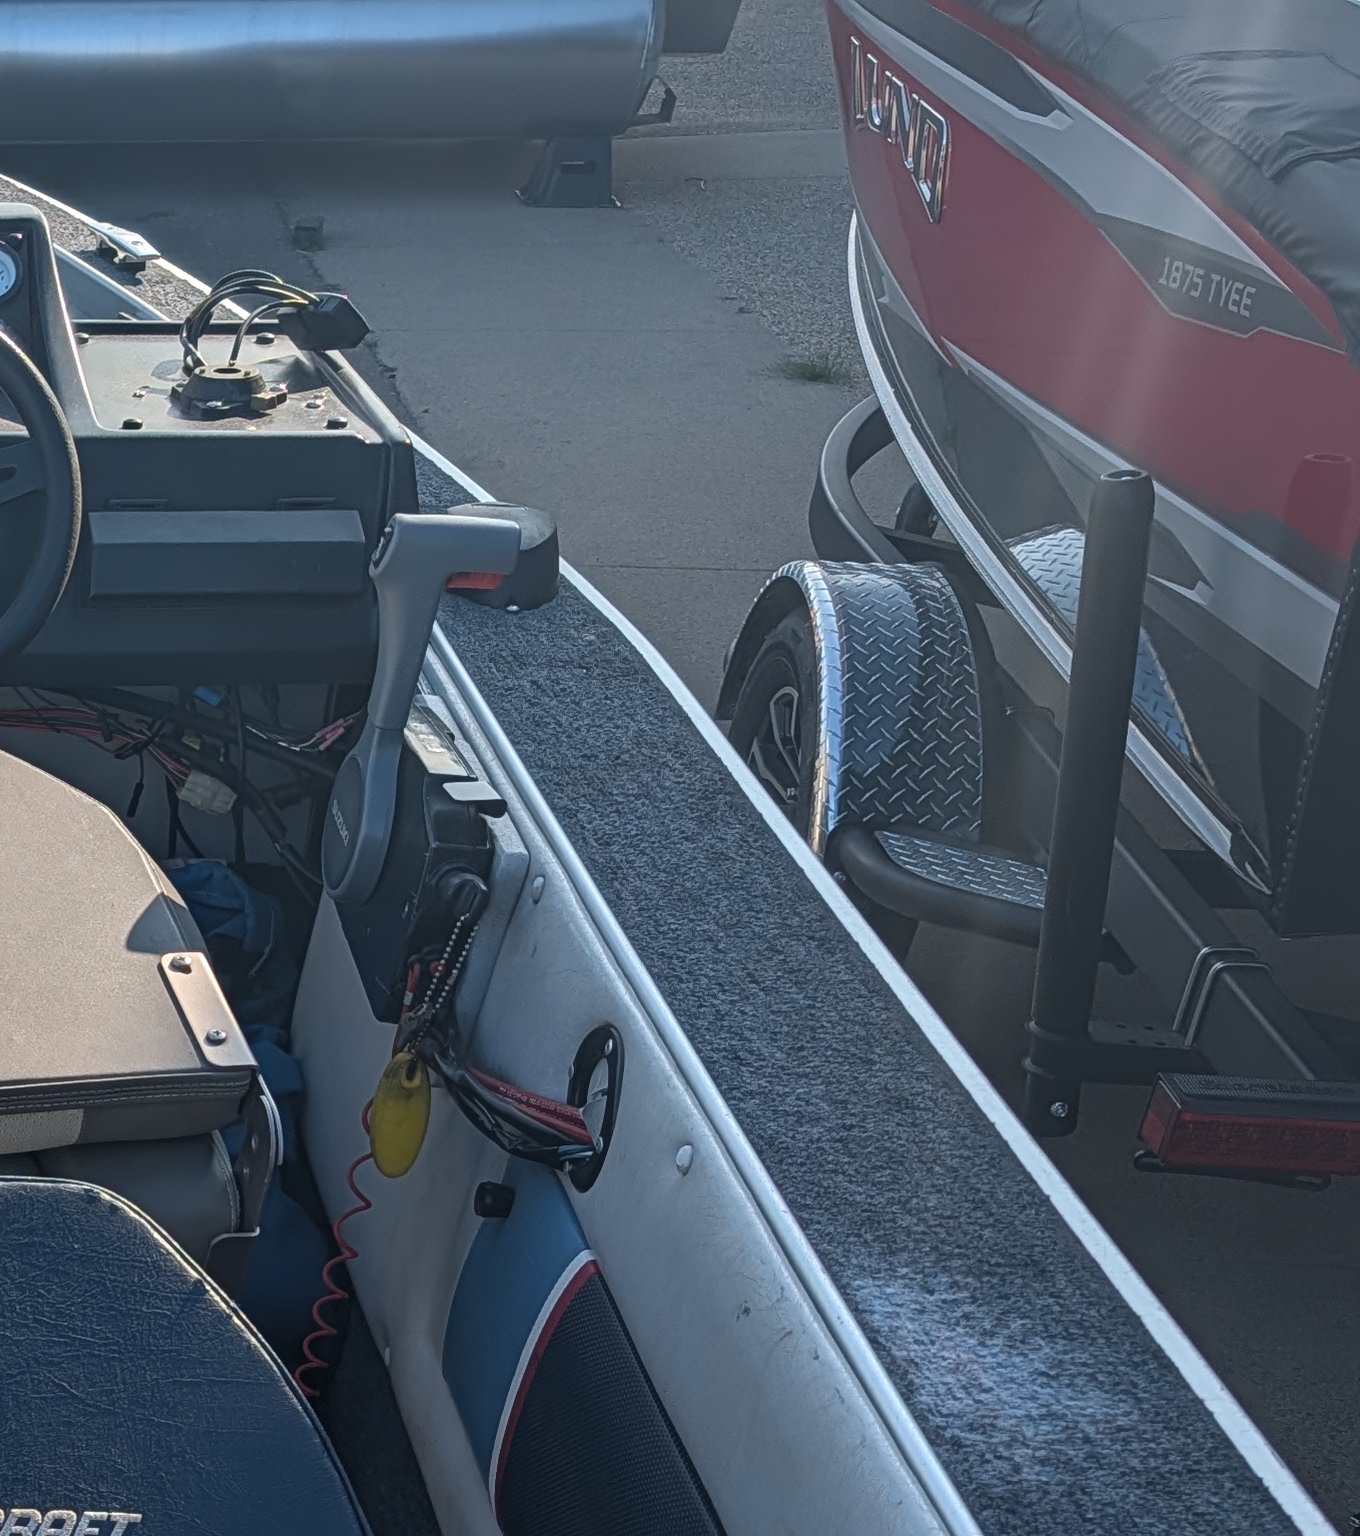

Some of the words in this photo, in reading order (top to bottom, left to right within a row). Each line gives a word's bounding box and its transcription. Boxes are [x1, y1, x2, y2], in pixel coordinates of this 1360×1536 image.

[850, 36, 948, 224] LUND
[1159, 257, 1205, 298] 1875
[1208, 273, 1257, 318] TYEE
